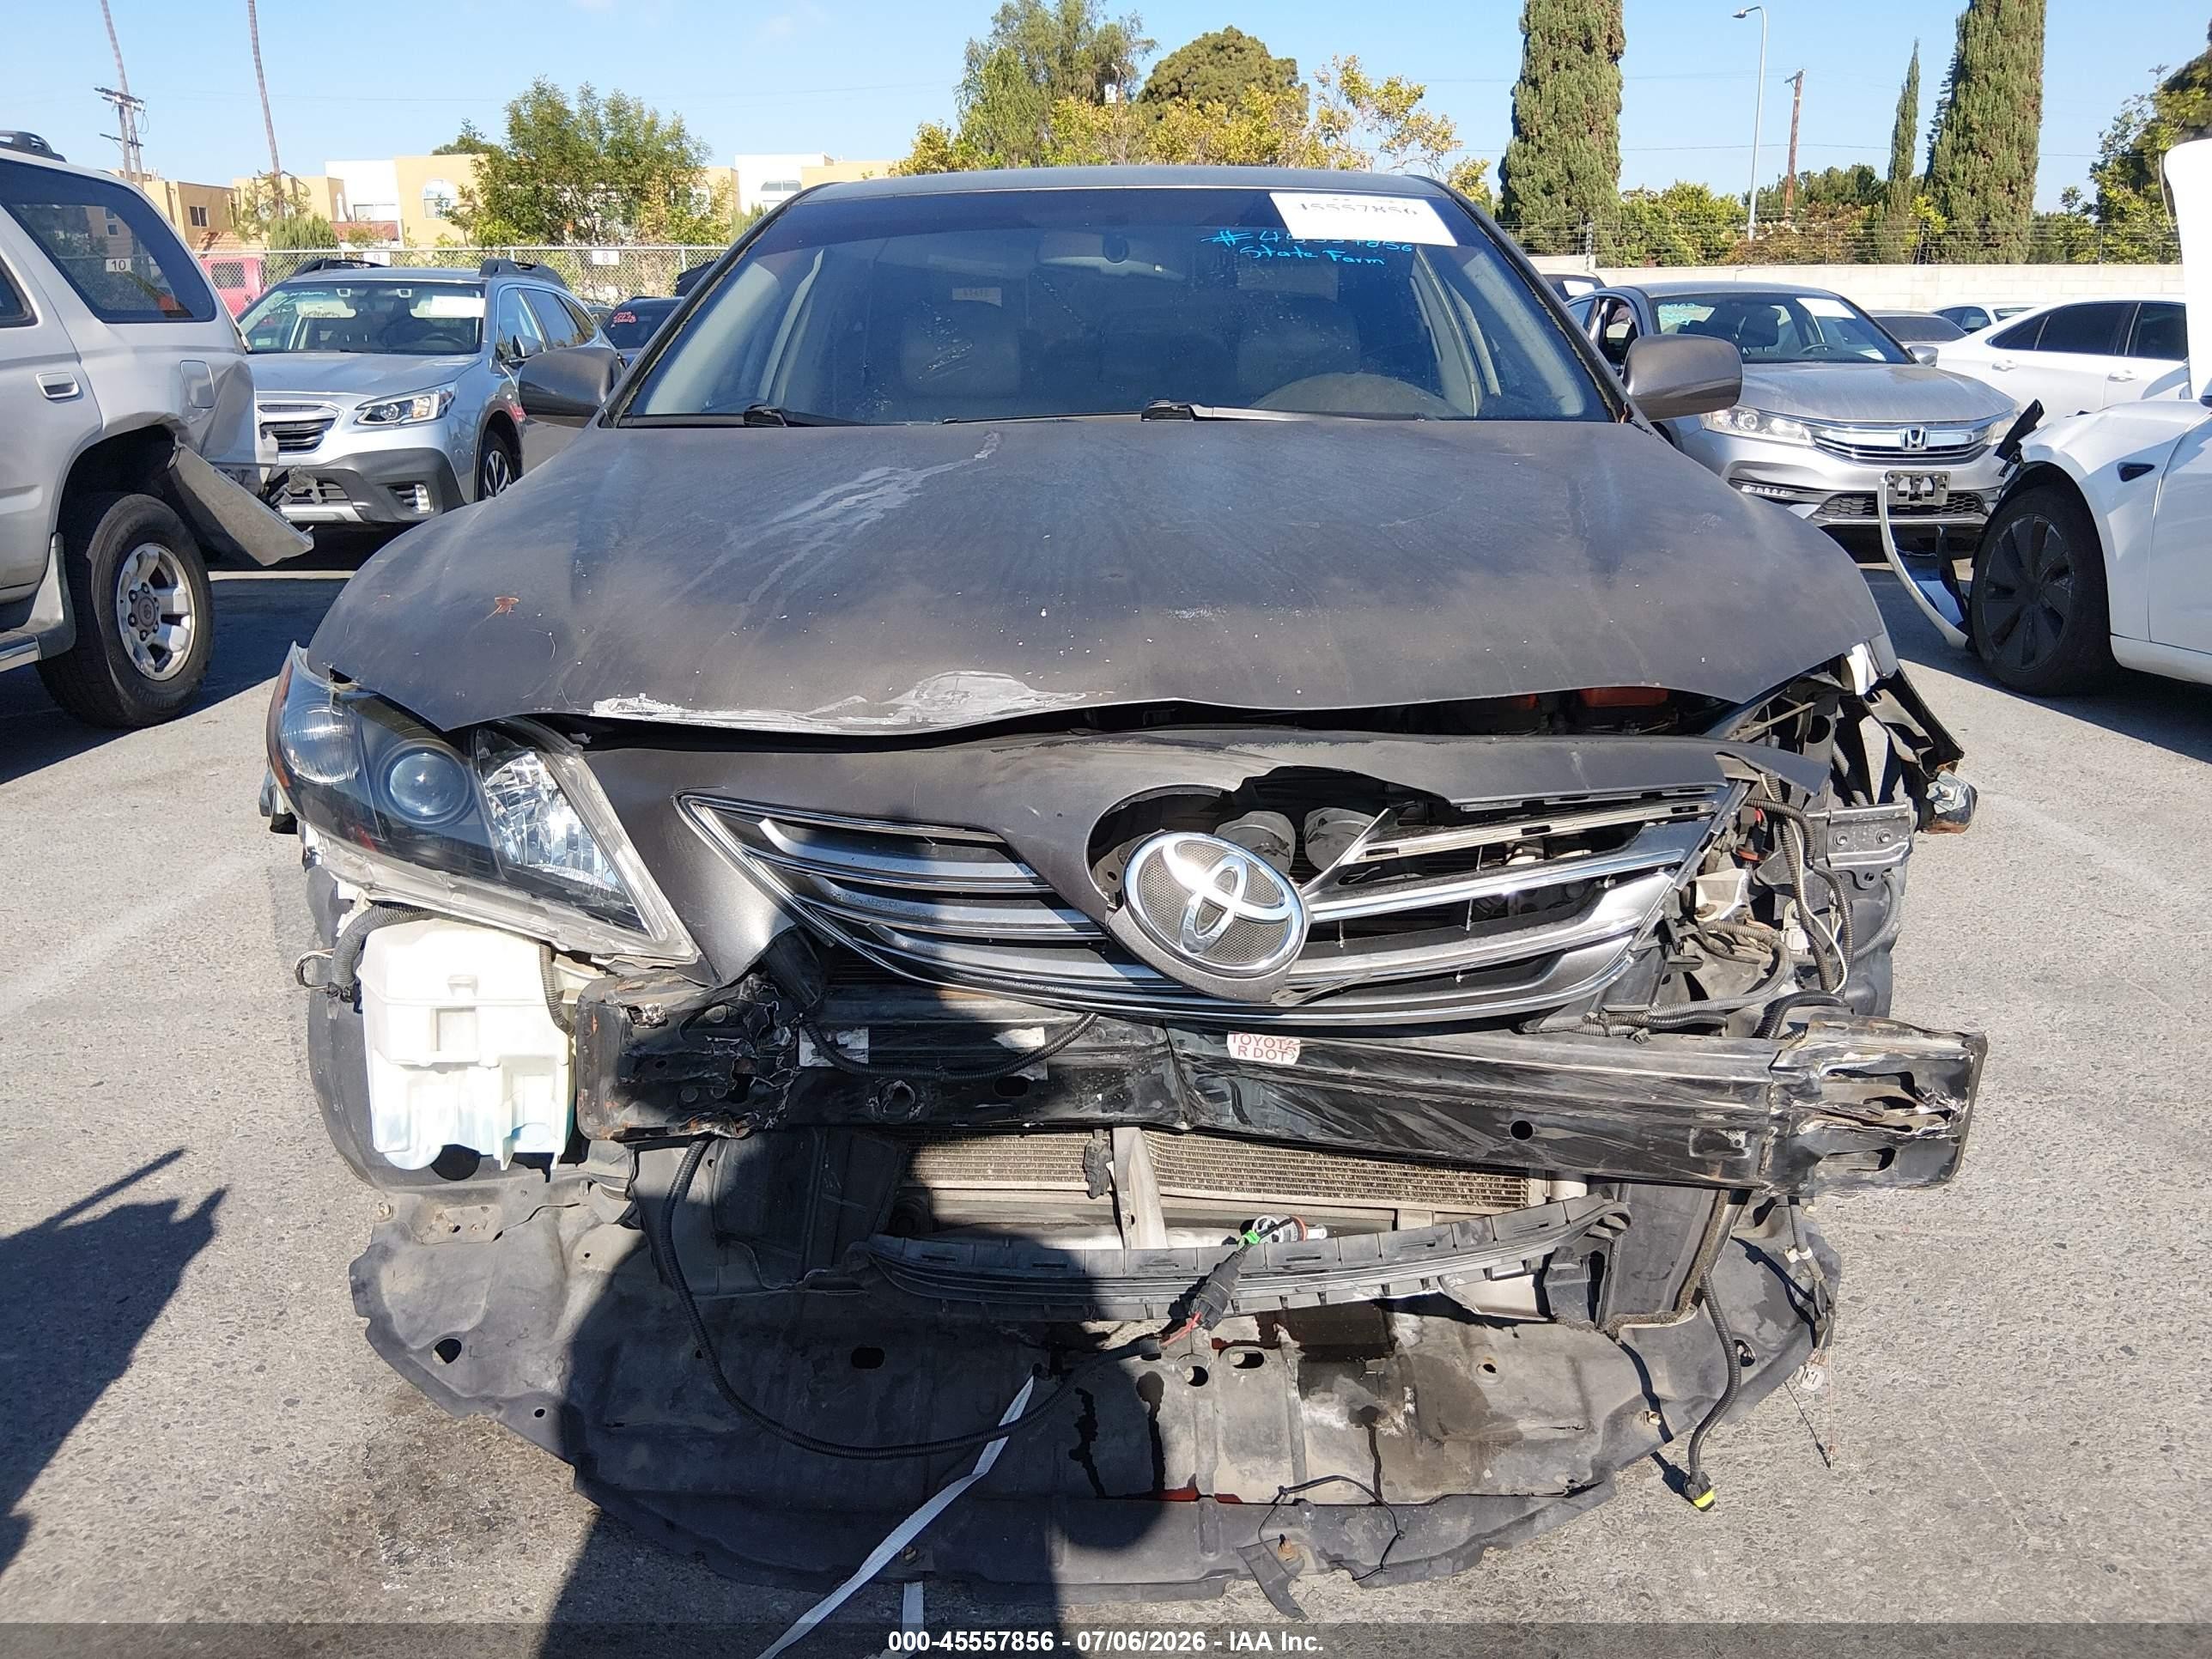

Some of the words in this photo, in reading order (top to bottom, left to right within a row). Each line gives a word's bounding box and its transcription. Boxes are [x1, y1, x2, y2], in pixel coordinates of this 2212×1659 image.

[603, 252, 610, 264] 8
[1239, 244, 1319, 258] State
[1322, 249, 1385, 265] Farm
[111, 259, 126, 270] 10
[1237, 1045, 1249, 1058] R
[1253, 1047, 1288, 1062] DOT
